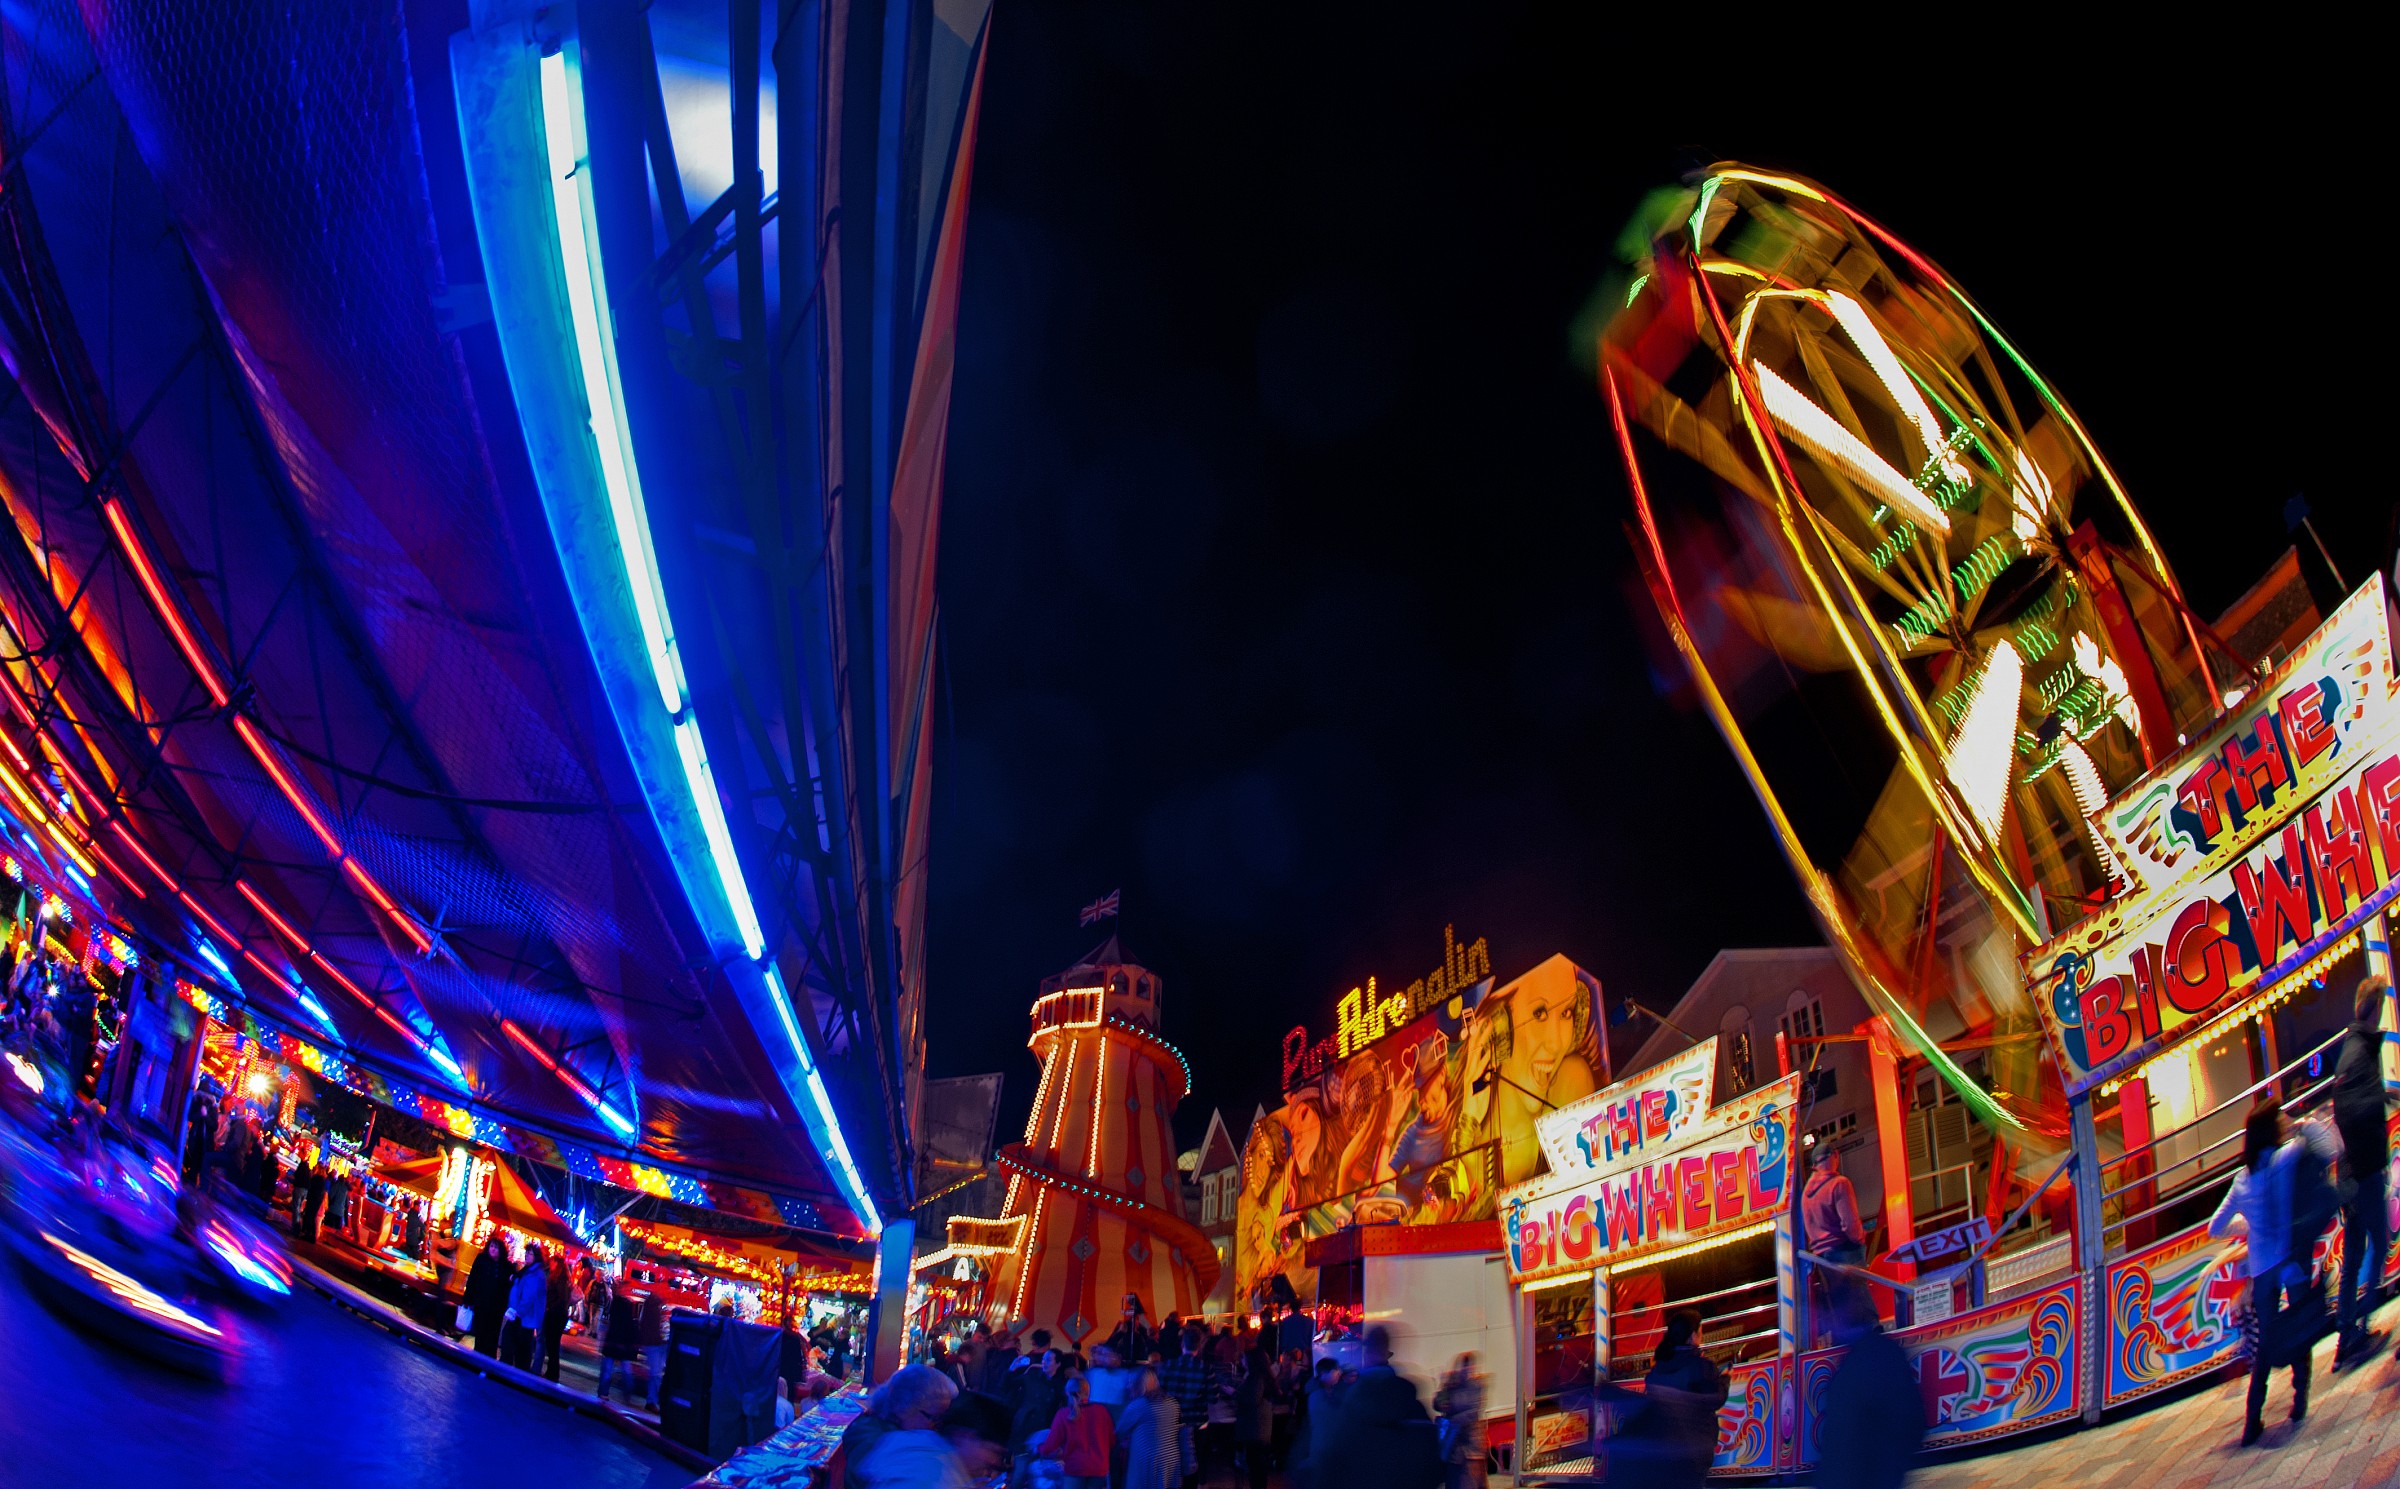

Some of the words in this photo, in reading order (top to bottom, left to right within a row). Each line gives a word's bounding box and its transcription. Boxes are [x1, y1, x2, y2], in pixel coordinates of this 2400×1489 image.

[2179, 681, 2336, 840] THE
[1337, 923, 1490, 1059] Adrenalin
[2079, 897, 2230, 1068] BIG
[1581, 1089, 1669, 1160] THE
[1519, 1195, 1594, 1272] BIG
[1601, 1146, 1778, 1252] WHEEL
[1919, 1220, 1985, 1255] EXIT
